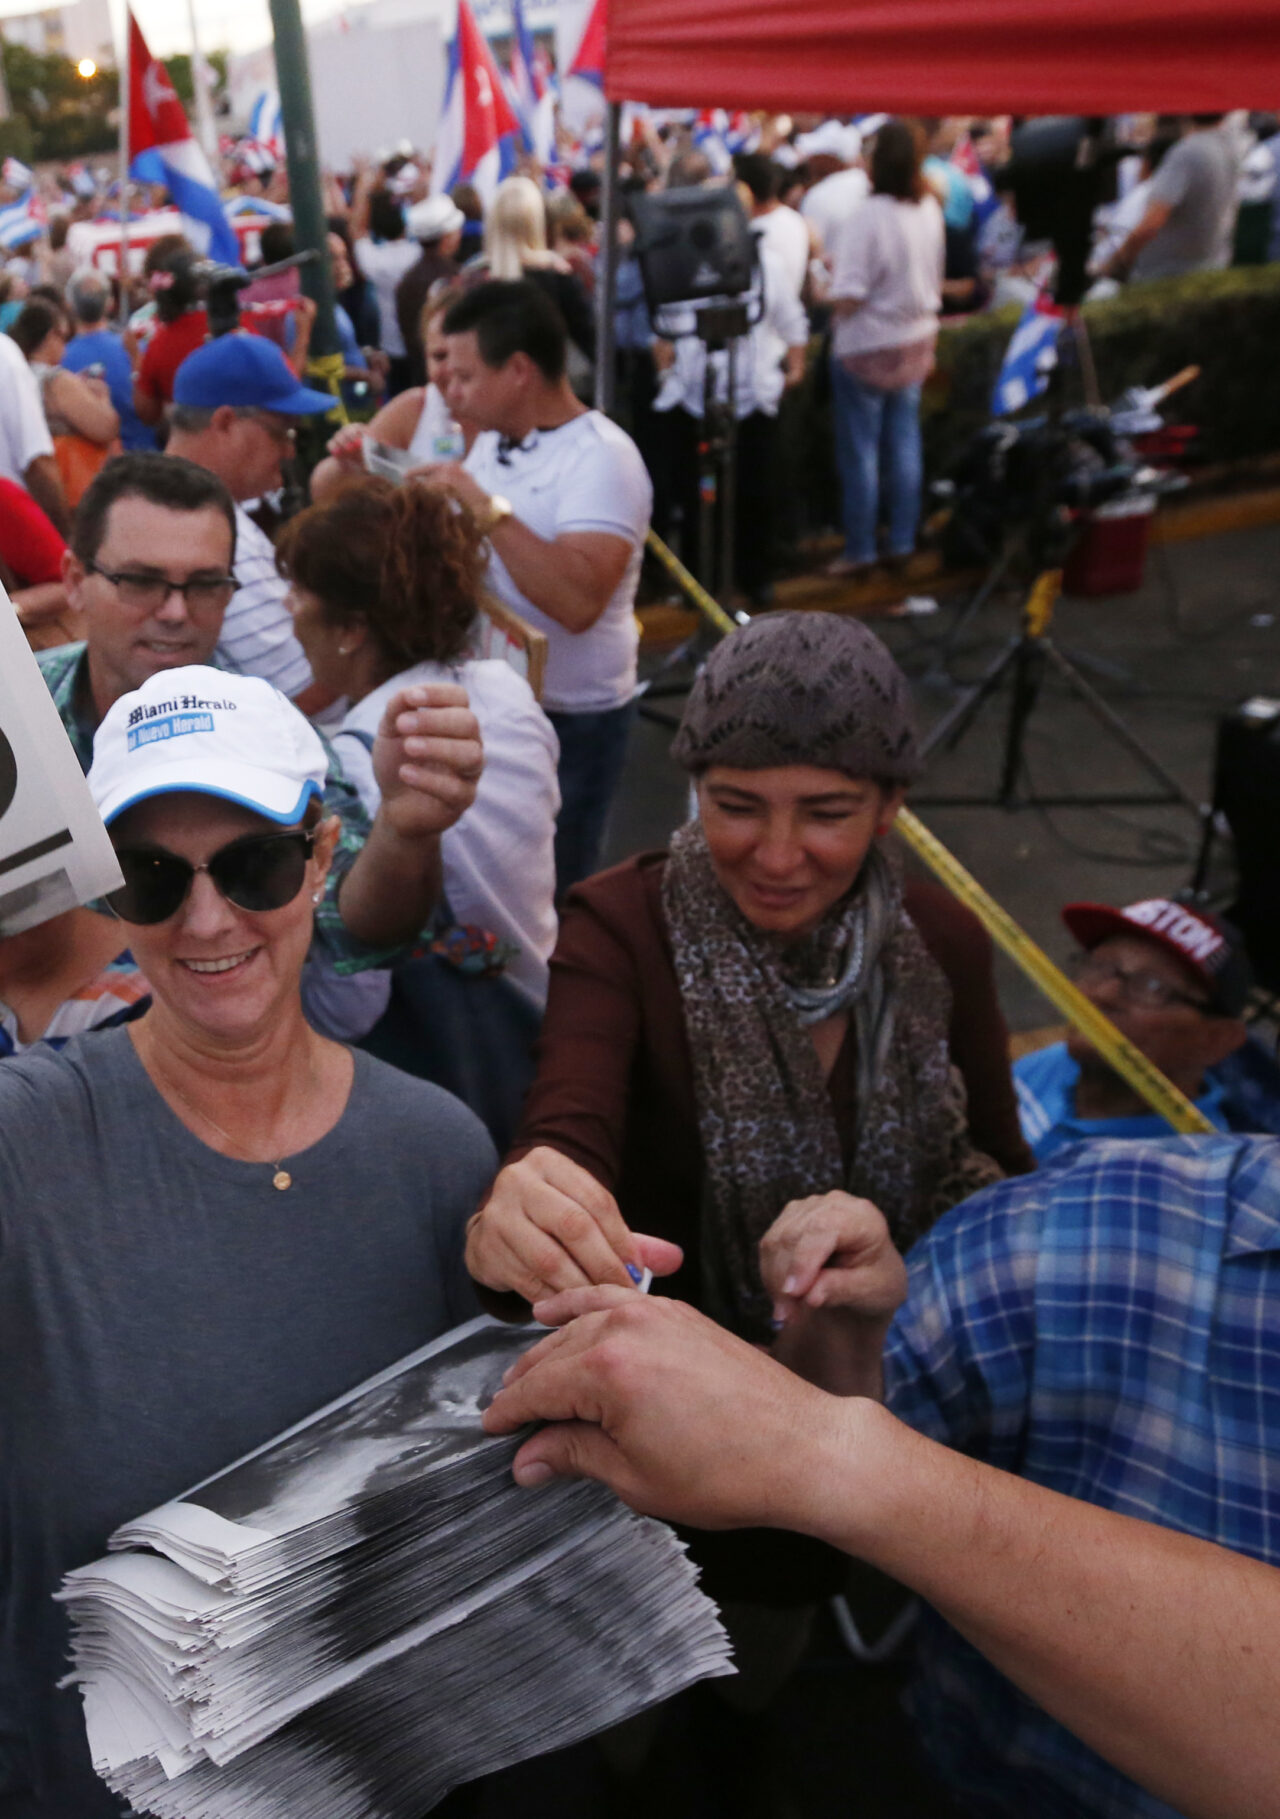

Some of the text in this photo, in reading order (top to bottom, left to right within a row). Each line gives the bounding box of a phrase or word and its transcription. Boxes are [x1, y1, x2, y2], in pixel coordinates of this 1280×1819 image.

[127, 697, 178, 728] Miami
[138, 722, 170, 744] Nuevo
[173, 715, 212, 734] Herald
